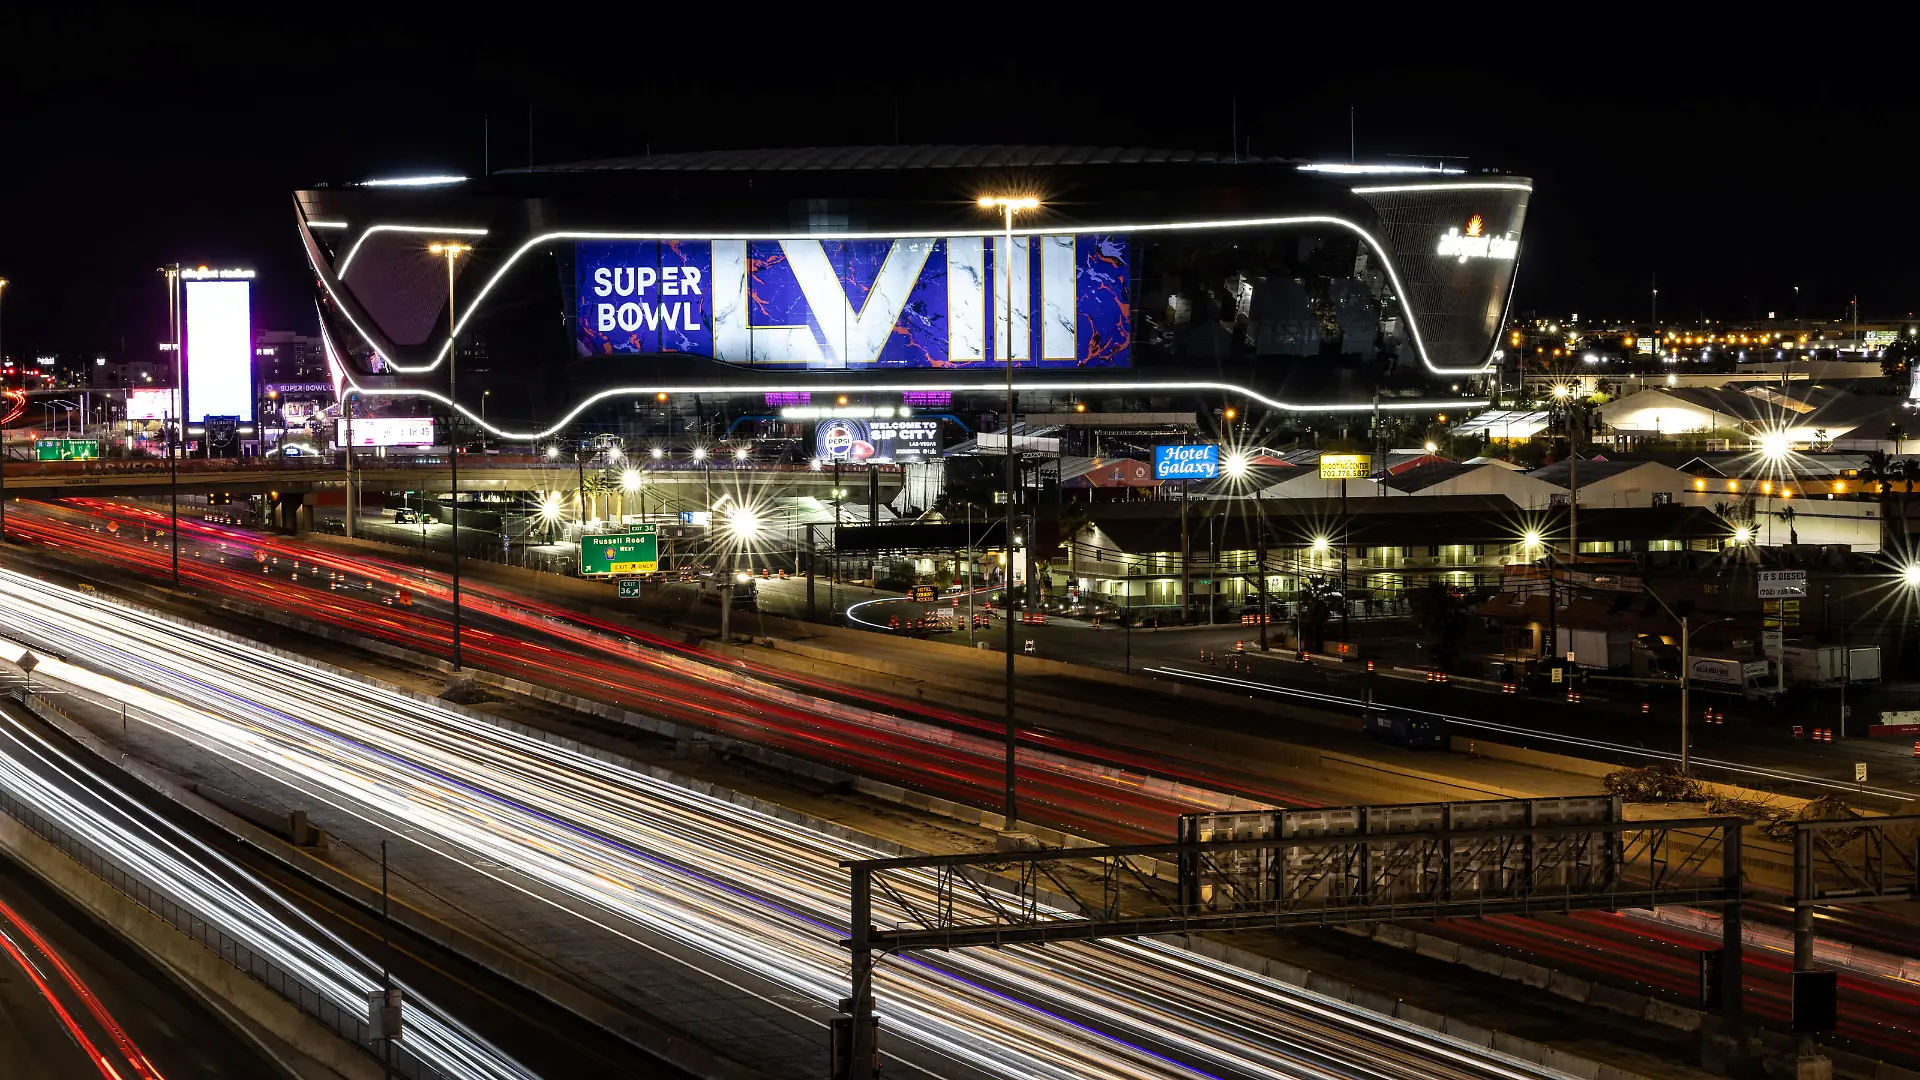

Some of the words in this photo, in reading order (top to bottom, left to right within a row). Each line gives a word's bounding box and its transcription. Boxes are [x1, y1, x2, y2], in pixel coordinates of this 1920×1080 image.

[594, 266, 702, 297] SUPER
[711, 234, 1077, 363] LVIII
[598, 302, 701, 332] BOWL
[869, 422, 922, 430] WELCOME
[871, 430, 896, 440] SIP
[898, 430, 936, 440] CITY
[1164, 445, 1212, 460] Hotel
[1158, 459, 1215, 478] Galaxy
[593, 537, 622, 545] Russell
[1771, 573, 1776, 581] S
[1778, 572, 1806, 581] DIESEL
